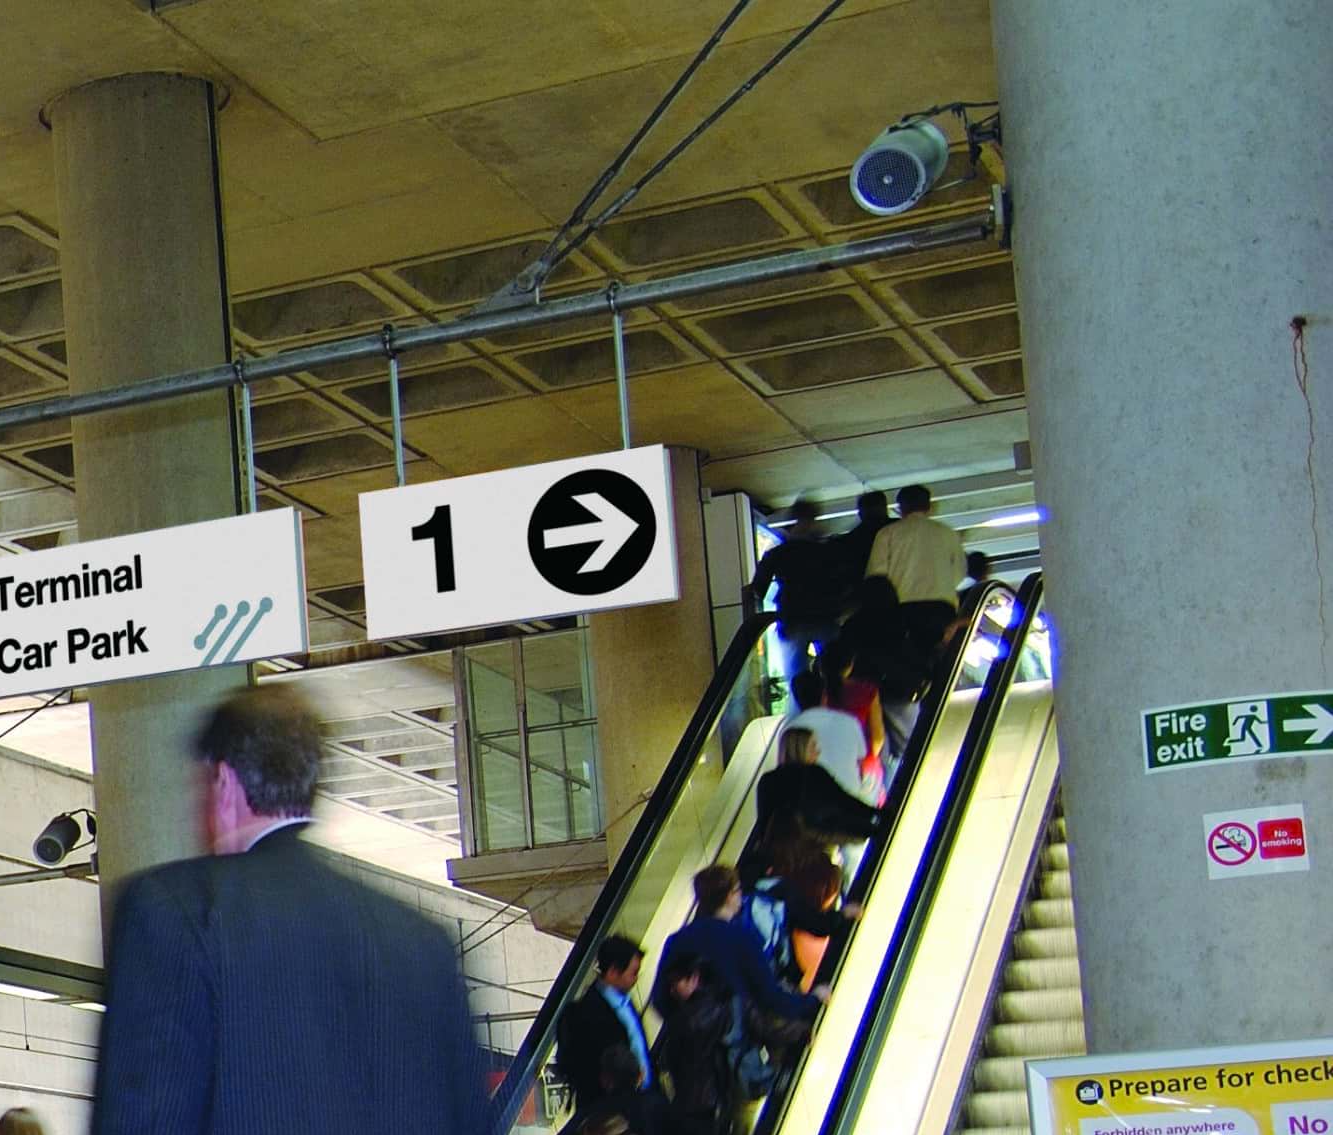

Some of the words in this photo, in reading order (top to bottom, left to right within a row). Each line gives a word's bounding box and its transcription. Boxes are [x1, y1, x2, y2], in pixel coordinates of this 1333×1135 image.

[410, 503, 456, 593] 1
[67, 619, 150, 664] Park
[1154, 711, 1207, 737] Fire
[1156, 736, 1205, 763] exit
[1261, 836, 1302, 848] smoking
[1274, 829, 1288, 838] No
[1109, 1075, 1207, 1097] Prepare
[1216, 1068, 1255, 1089] for
[1166, 1121, 1236, 1135] anywhere
[1289, 1115, 1328, 1135] No
